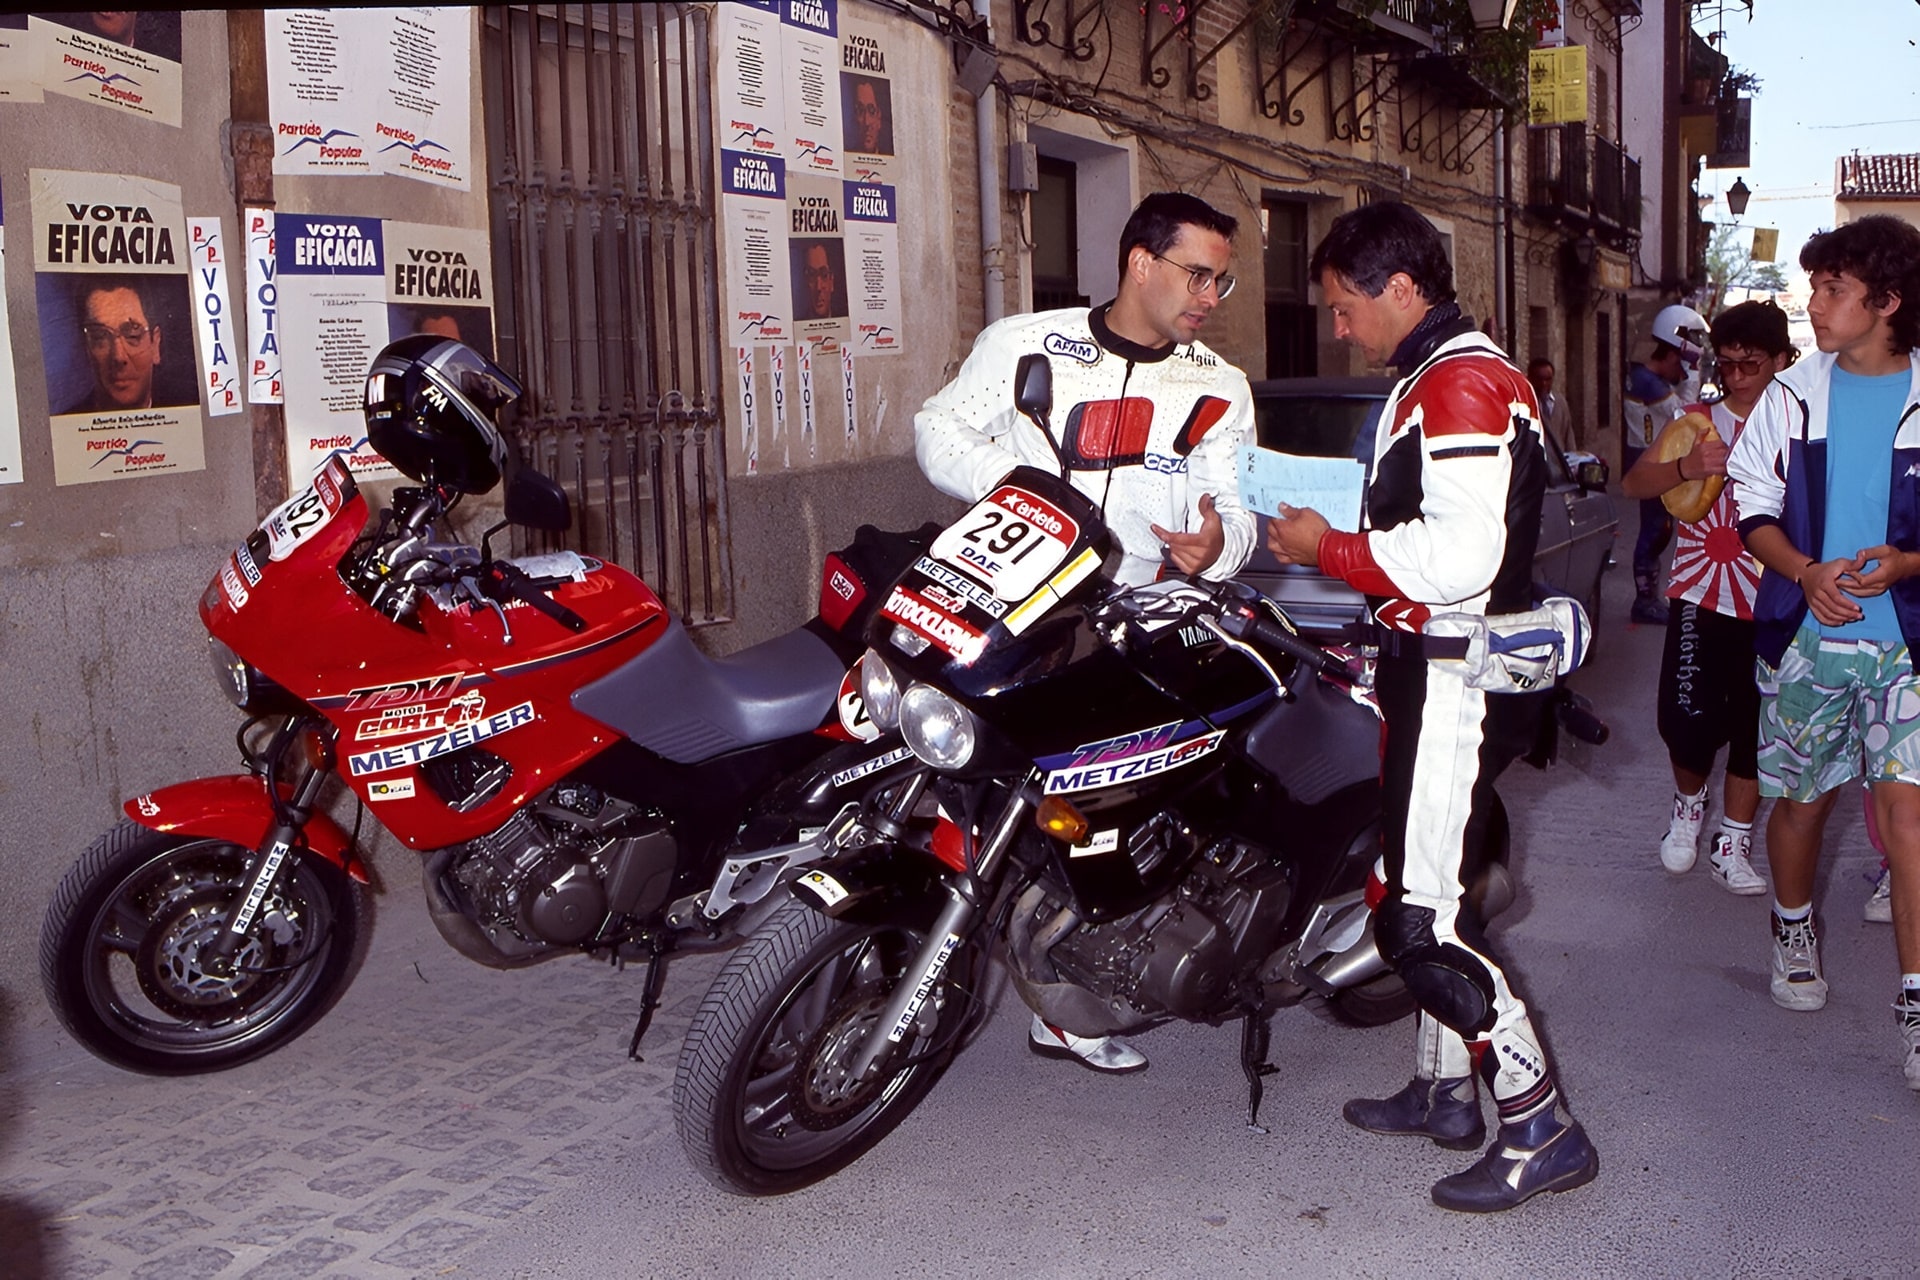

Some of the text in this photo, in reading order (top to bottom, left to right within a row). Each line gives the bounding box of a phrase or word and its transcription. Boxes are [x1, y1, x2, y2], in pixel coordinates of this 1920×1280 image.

[849, 34, 878, 49] VOTA
[64, 53, 106, 74] Partido
[843, 45, 886, 73] EFICACIA
[101, 83, 144, 104] Popular
[278, 122, 322, 136] Partido
[376, 122, 416, 143] Partido
[319, 146, 363, 160] Popular
[411, 153, 452, 171] Popular
[740, 157, 768, 169] VOTA
[733, 167, 776, 193] EFICACIA
[798, 197, 830, 208] VOTA
[857, 188, 882, 198] VOTA
[66, 203, 154, 223] VOTA
[853, 197, 888, 217] EFICACIA
[306, 224, 362, 238] VOTA
[792, 209, 838, 233] EFICACIA
[48, 223, 175, 265] EFICACIA
[295, 237, 377, 267] EFICACIA
[407, 248, 468, 266] VOTA
[395, 264, 482, 299] EFICACIA
[202, 267, 228, 365] VOTA
[258, 258, 279, 355] VOTA
[1053, 338, 1092, 358] AFAM
[421, 385, 449, 413] FM
[86, 438, 128, 451] Partido
[310, 434, 353, 450] Partido
[125, 453, 166, 466] Popular
[349, 455, 388, 468] Popula
[1016, 501, 1063, 534] ariete
[963, 512, 1046, 566] 291
[961, 547, 1003, 574] DAF
[917, 557, 1003, 615] METZELER
[345, 671, 466, 712] TDM
[384, 706, 424, 718] MOTOS
[351, 704, 533, 774] METZELER
[1069, 719, 1184, 768] TDM
[835, 746, 916, 786] METZELE
[1050, 735, 1217, 791] METZELER
[236, 845, 286, 931] METZELER
[893, 938, 957, 1036] METZELER
